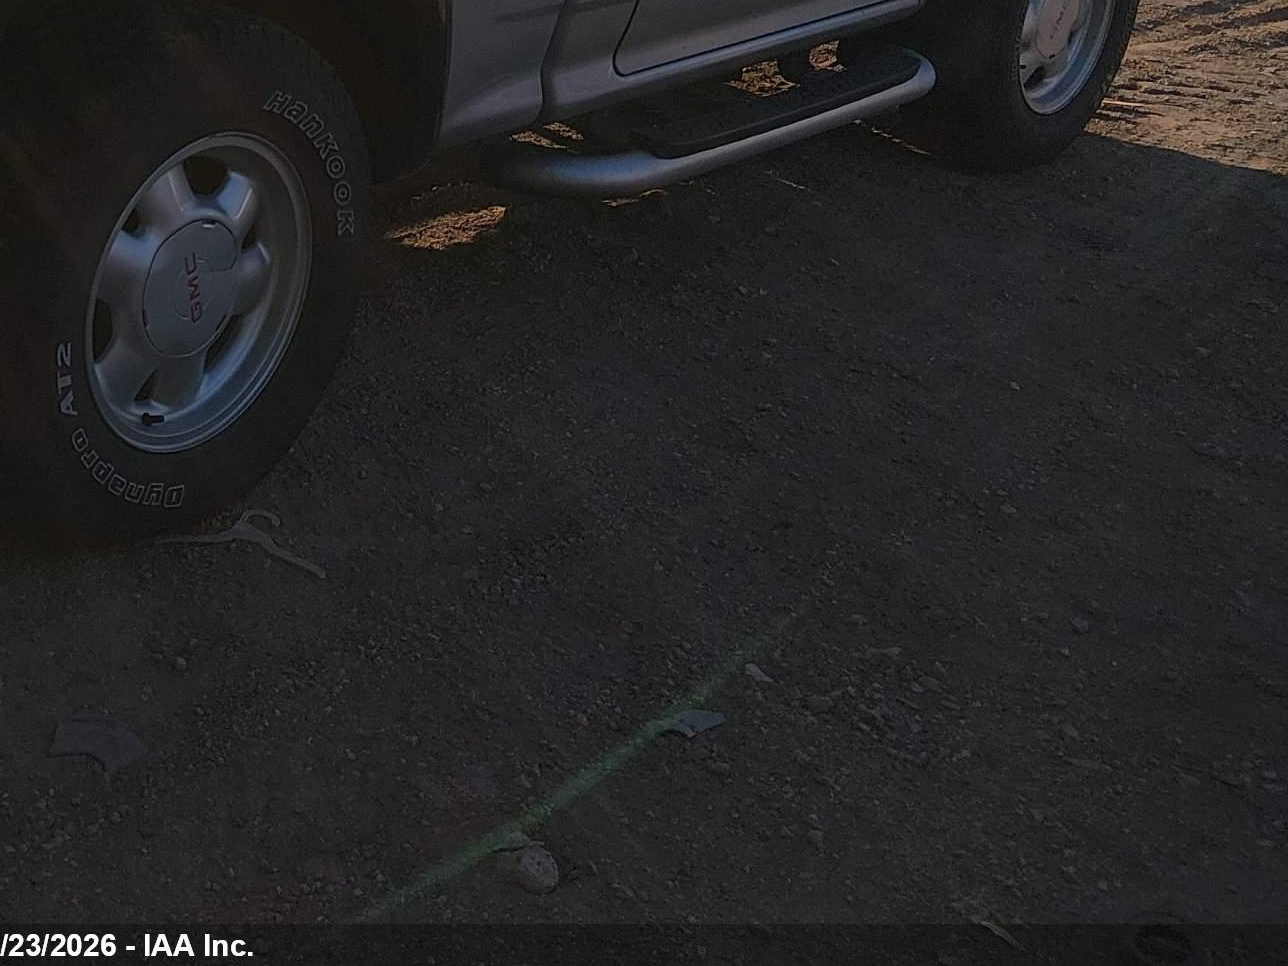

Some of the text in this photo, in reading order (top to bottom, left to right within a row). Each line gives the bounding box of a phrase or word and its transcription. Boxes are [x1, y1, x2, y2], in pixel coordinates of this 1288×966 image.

[184, 252, 202, 323] GMC
[56, 341, 185, 509] Dynapro AT2
